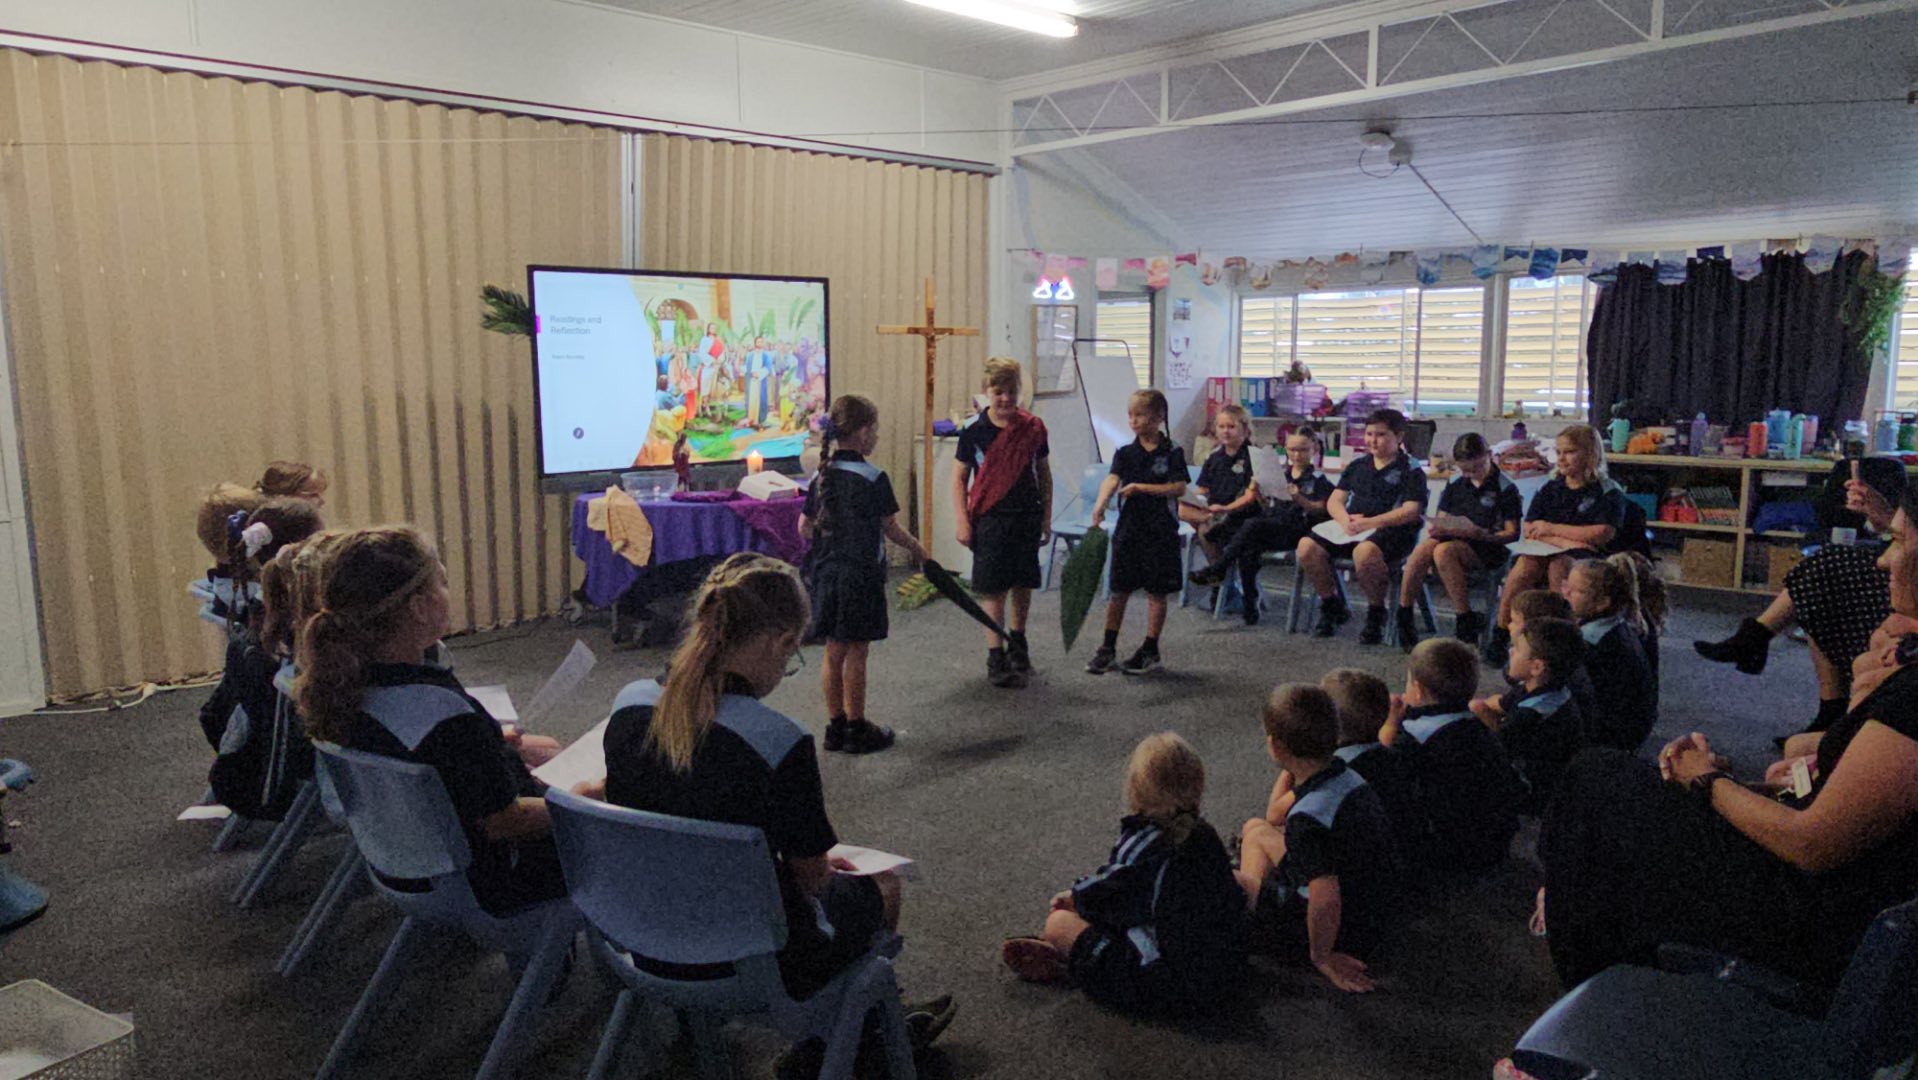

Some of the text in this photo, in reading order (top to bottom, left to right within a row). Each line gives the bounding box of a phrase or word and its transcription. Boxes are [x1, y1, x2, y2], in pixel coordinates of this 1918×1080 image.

[550, 314, 602, 325] Readings and
[550, 326, 591, 335] Reflection
